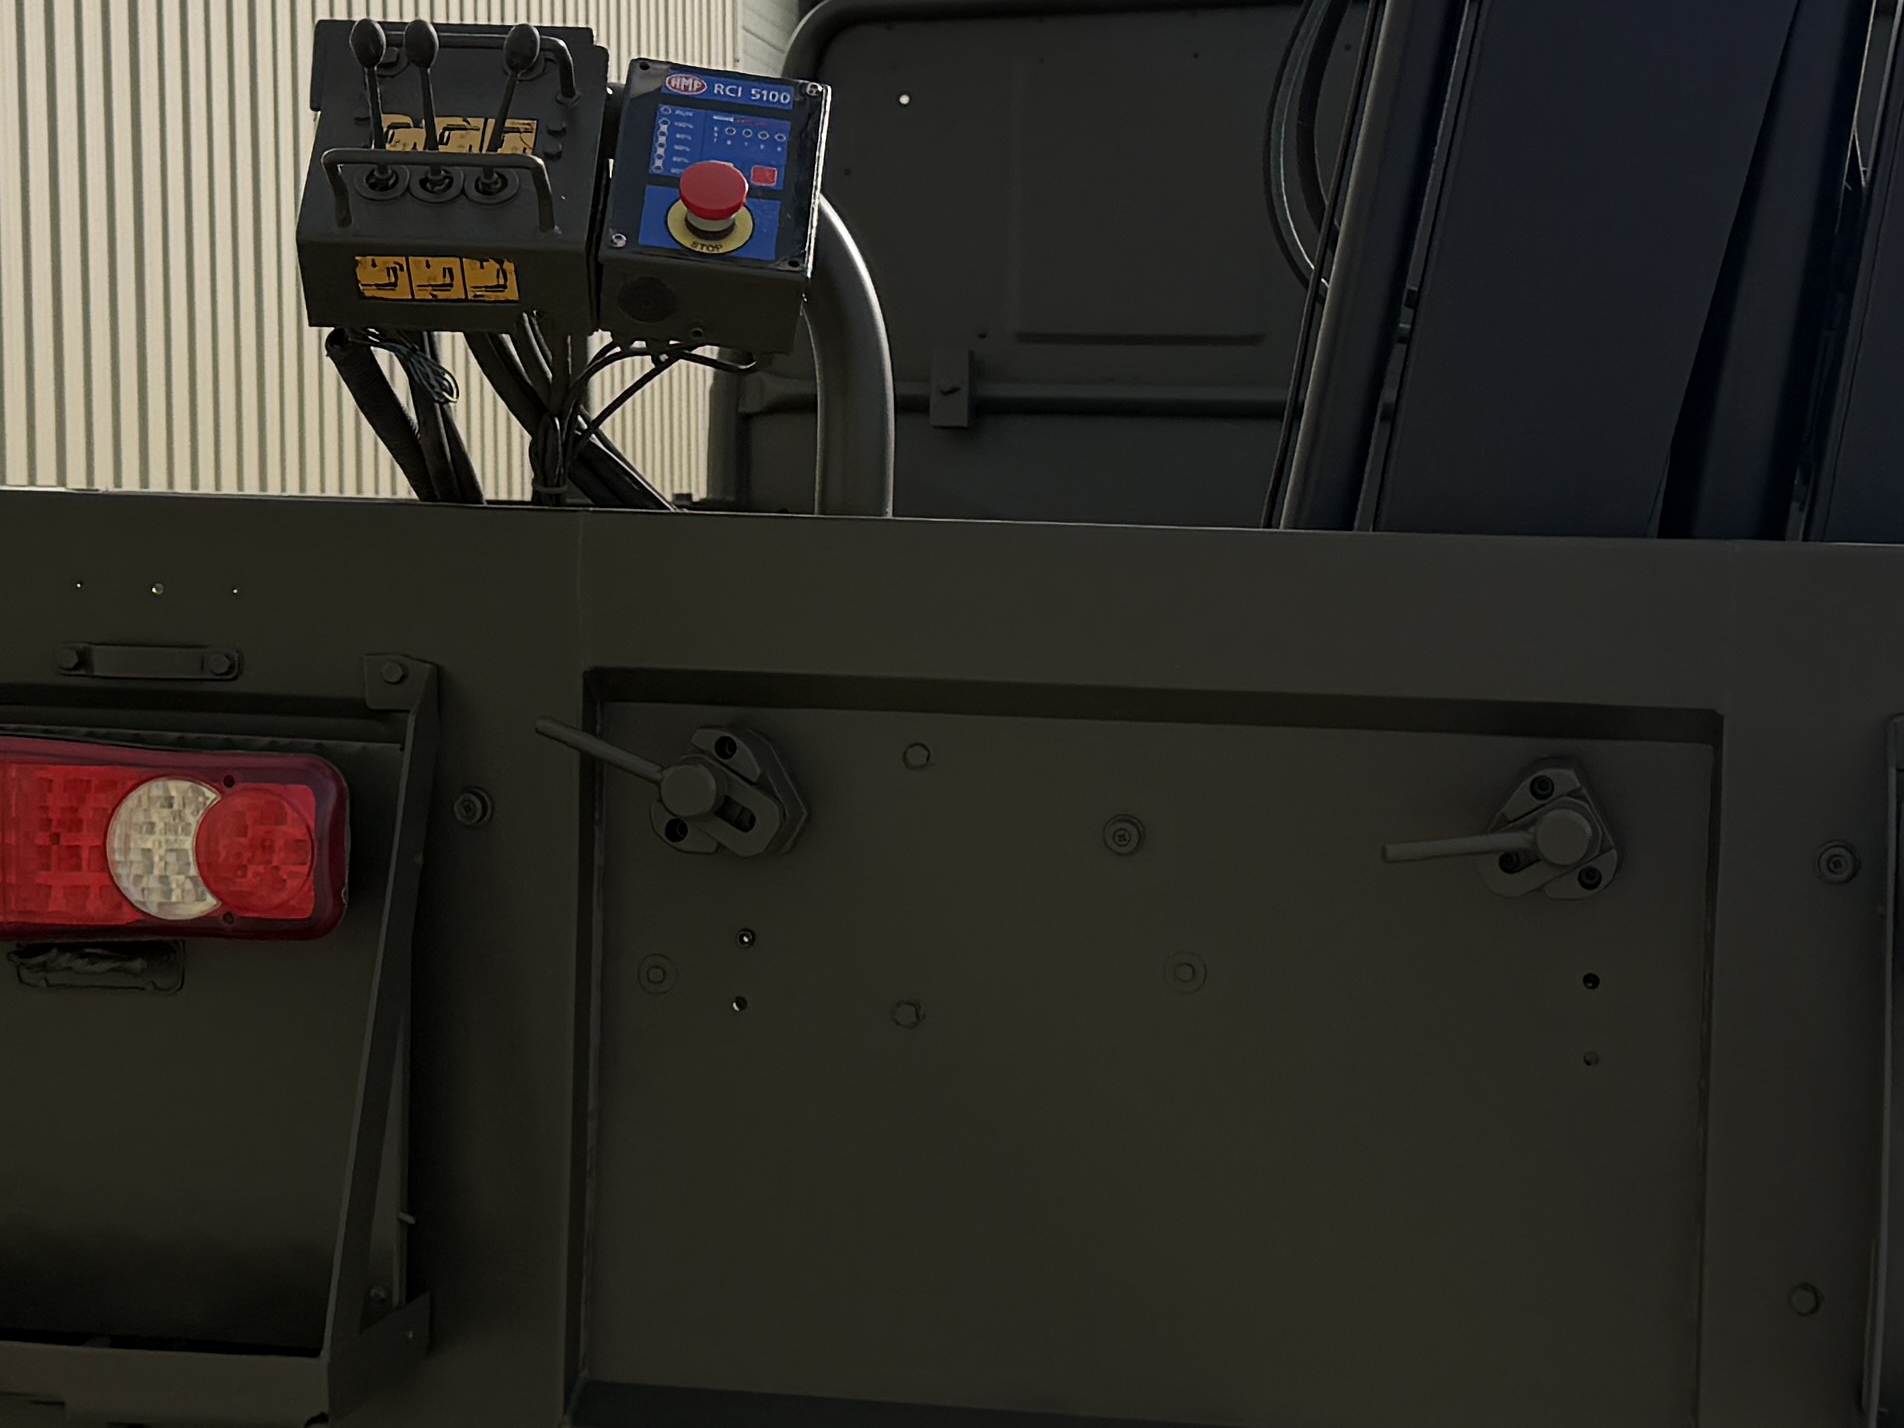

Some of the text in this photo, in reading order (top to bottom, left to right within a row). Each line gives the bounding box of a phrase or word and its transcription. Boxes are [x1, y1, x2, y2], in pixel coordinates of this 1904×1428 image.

[714, 83, 743, 98] RCI
[751, 88, 791, 104] 5100
[691, 241, 723, 253] STOP
